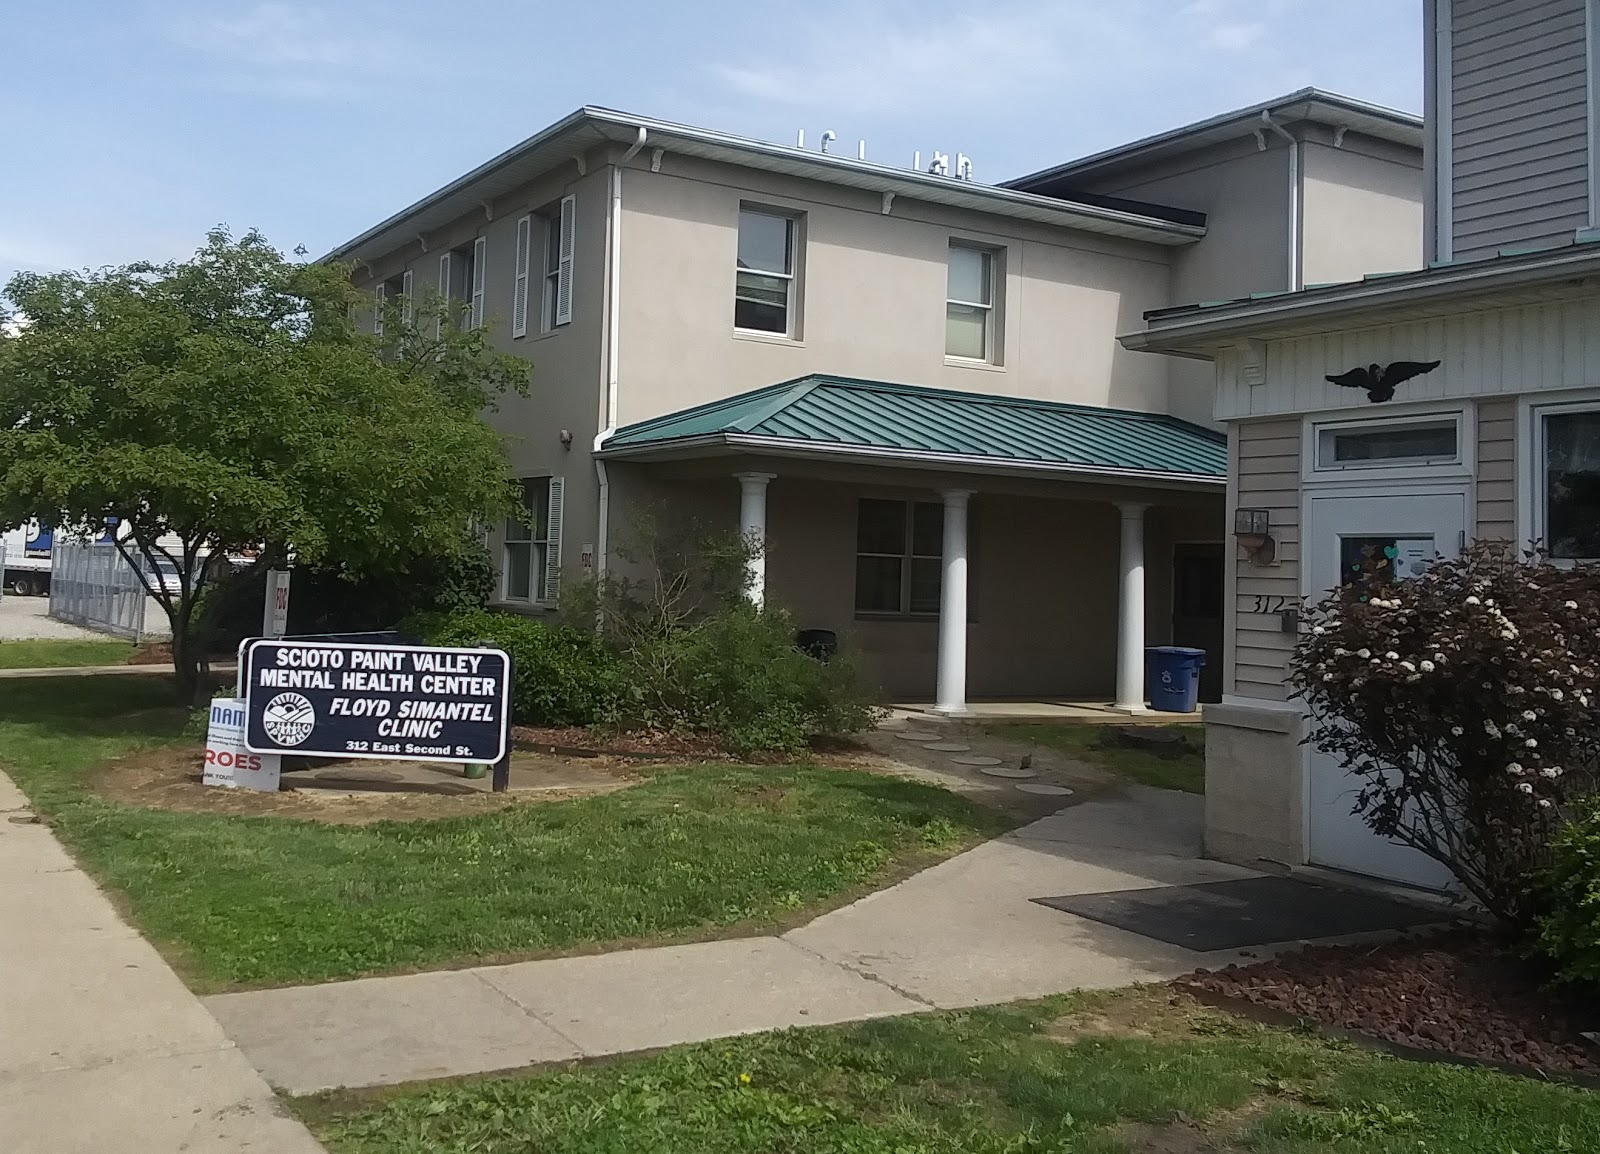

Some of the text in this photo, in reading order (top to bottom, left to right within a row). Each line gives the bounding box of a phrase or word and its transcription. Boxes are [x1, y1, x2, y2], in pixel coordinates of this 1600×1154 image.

[1254, 595, 1285, 614] 312
[276, 648, 482, 674] SCIOTO PAINT VALLEY
[260, 668, 495, 696] MENTAL HEALTH CENTER
[329, 698, 494, 722] FLOYD SIMANTEL
[266, 722, 311, 744] SPVMHC
[377, 718, 443, 738] CLINIC
[346, 740, 473, 757] 312 East Second St.
[205, 749, 262, 771] ROES
